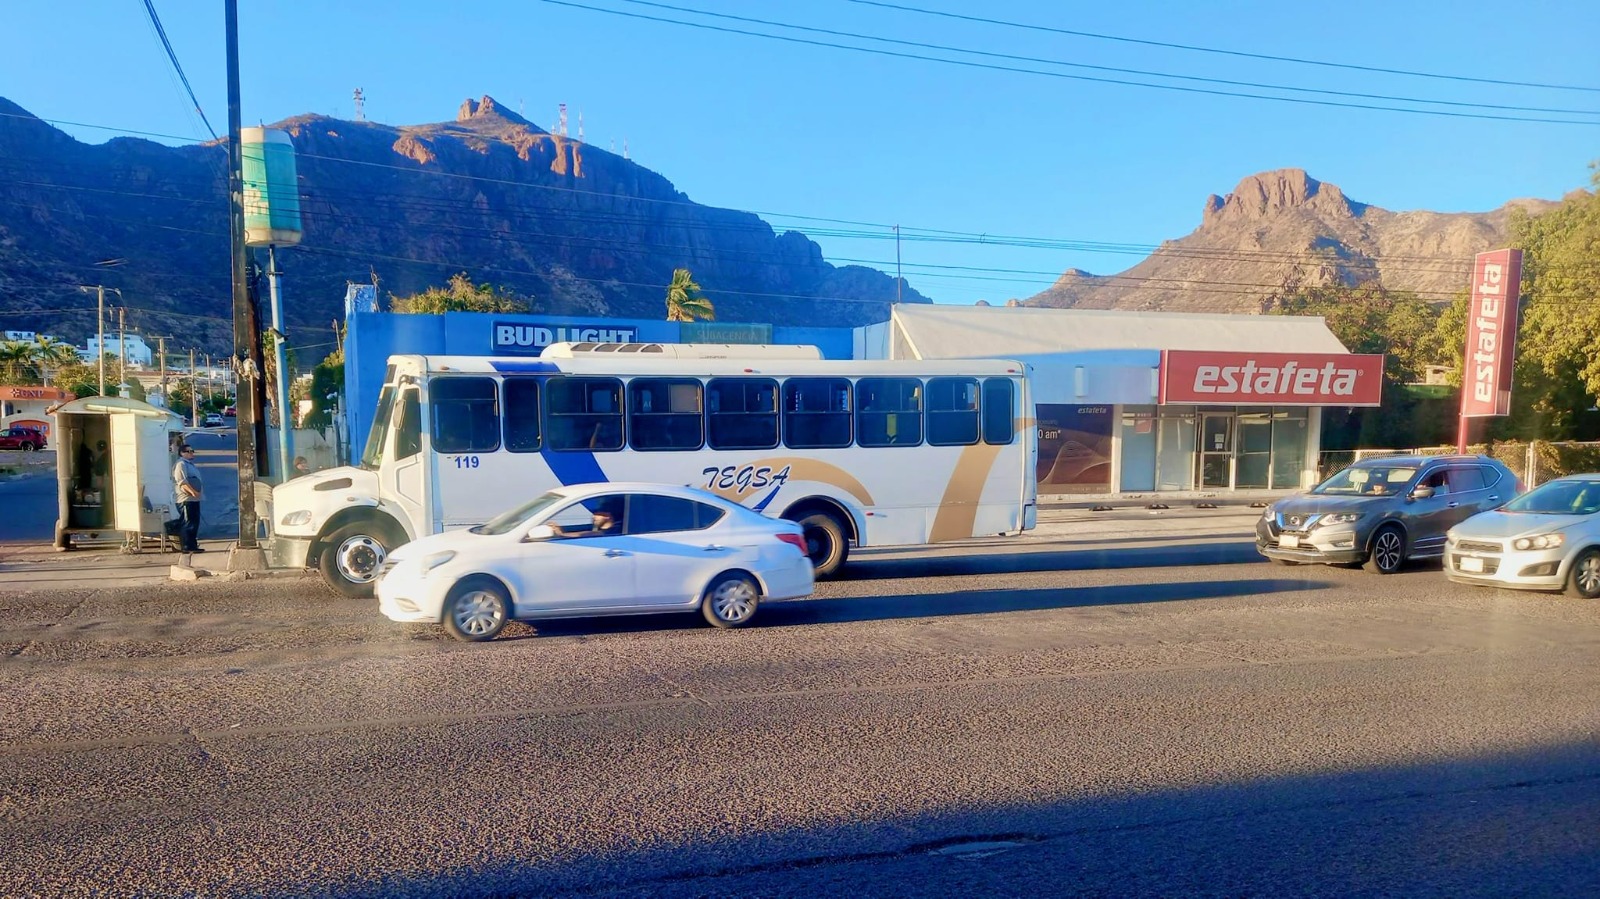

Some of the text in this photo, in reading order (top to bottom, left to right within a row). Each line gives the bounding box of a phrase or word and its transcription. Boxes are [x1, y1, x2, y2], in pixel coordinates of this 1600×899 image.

[497, 325, 554, 347] BUD
[697, 329, 759, 341] SUBAGENCIA
[454, 455, 480, 468] 119
[702, 465, 790, 493] TEGSA
